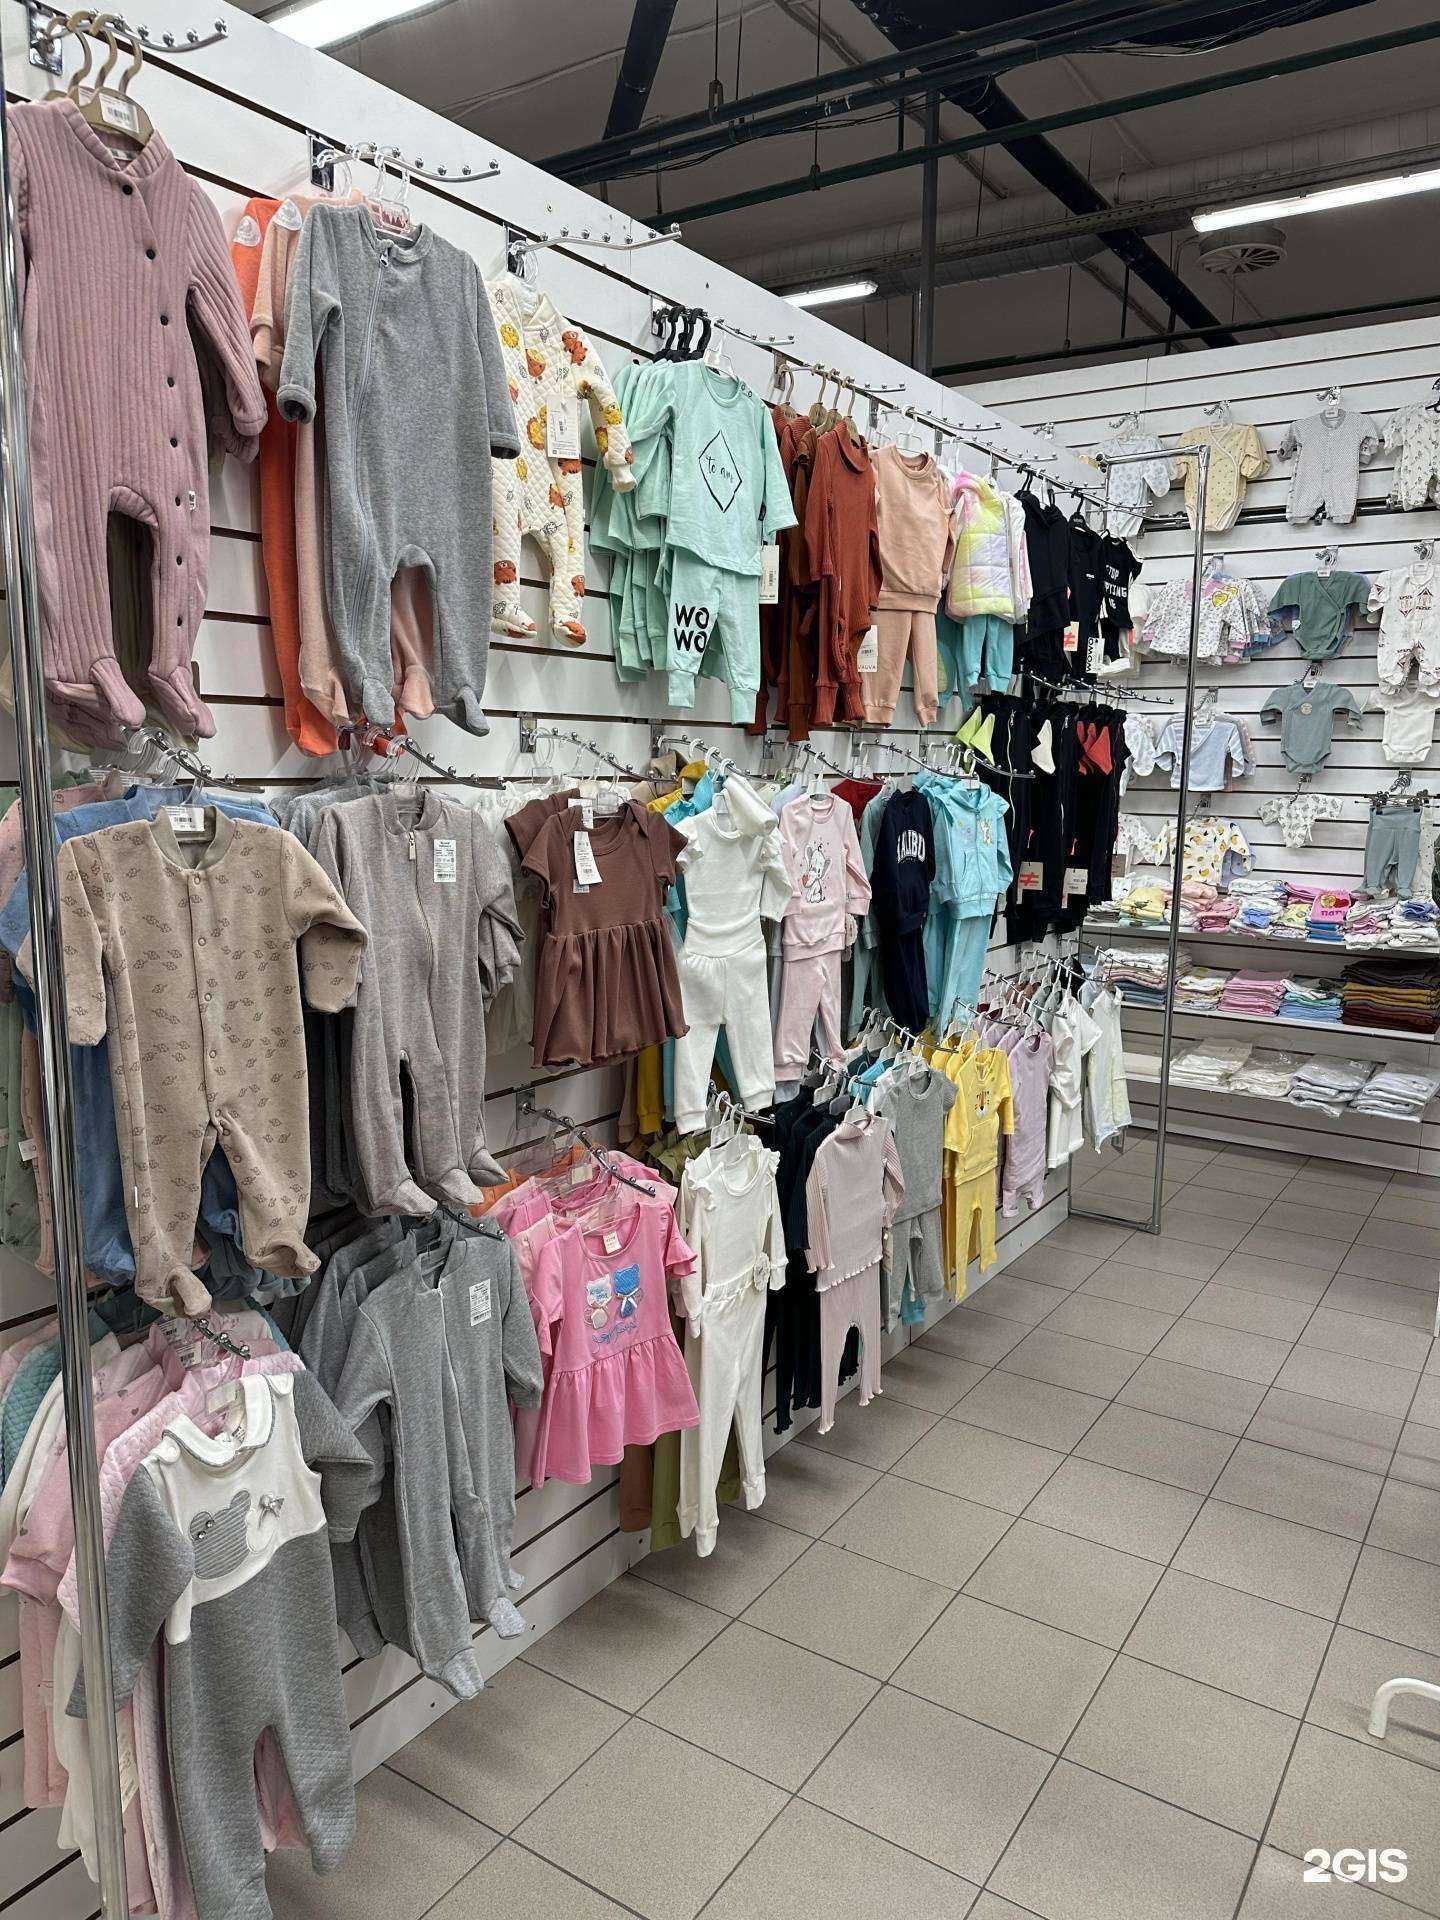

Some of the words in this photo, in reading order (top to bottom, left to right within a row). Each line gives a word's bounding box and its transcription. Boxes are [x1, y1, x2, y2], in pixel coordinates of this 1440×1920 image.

[675, 603, 709, 629] WO
[674, 628, 707, 653] WO
[1086, 637, 1094, 672] WOWO
